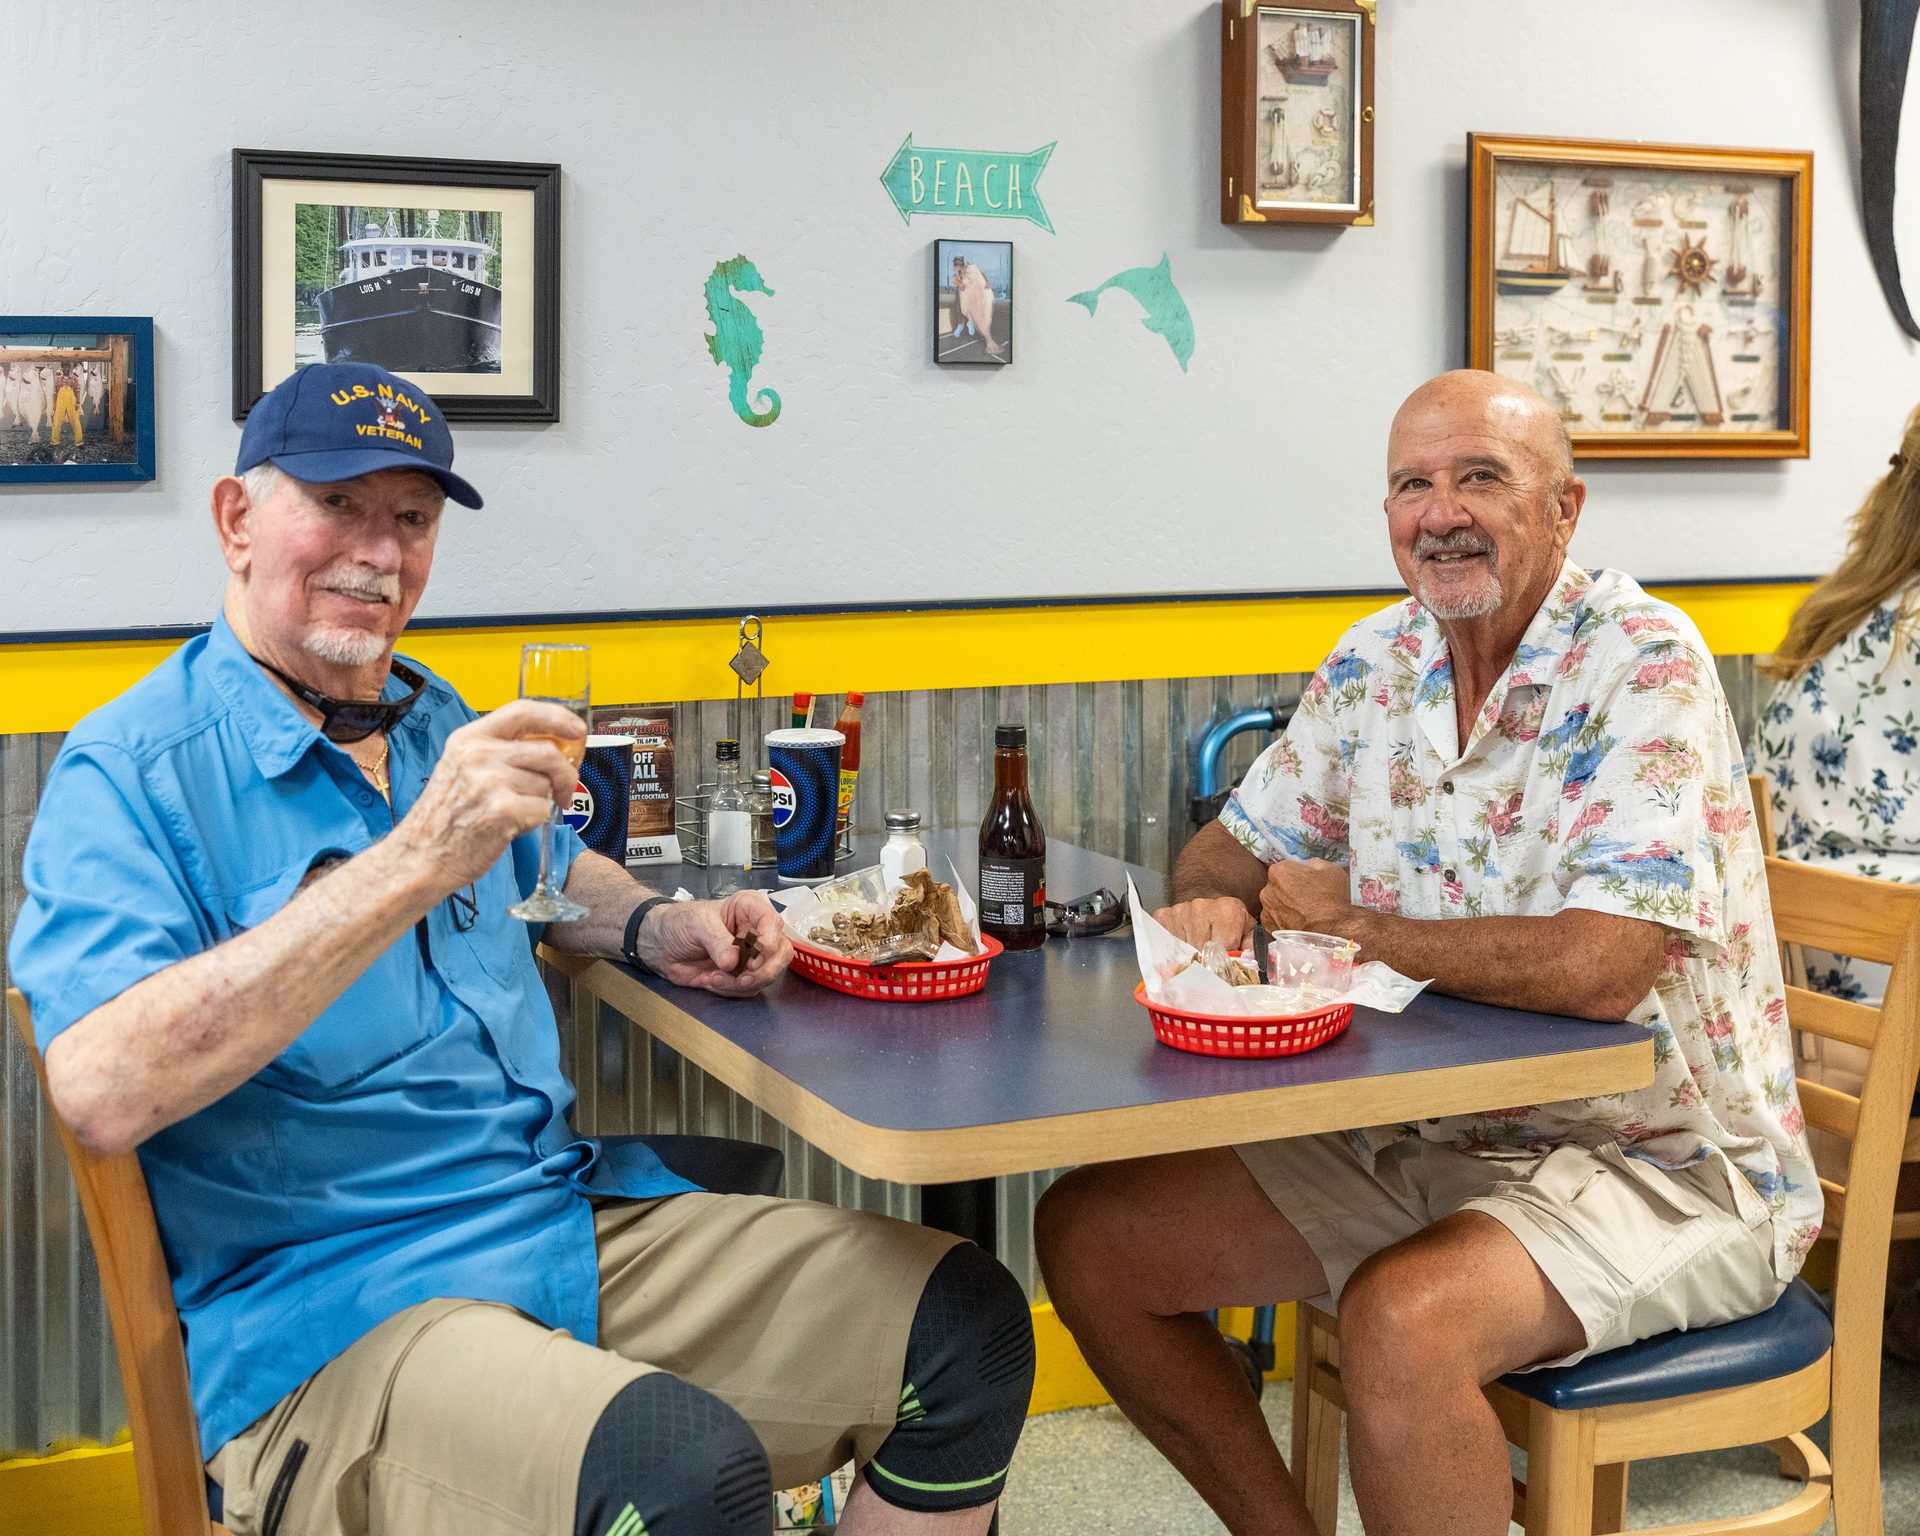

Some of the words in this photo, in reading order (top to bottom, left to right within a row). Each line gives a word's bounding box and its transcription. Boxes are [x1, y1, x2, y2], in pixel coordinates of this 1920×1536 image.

[910, 156, 1023, 210] BEACH
[359, 283, 374, 294] LOIS
[374, 282, 381, 291] M
[460, 283, 473, 295] LOIS
[473, 287, 482, 297] M
[330, 385, 376, 406] U.S.
[377, 383, 432, 424] NAVY
[355, 424, 423, 449] VETERAN
[597, 725, 636, 735] HAPPY
[636, 724, 669, 736] HOUR
[632, 751, 654, 764] OFF
[632, 764, 659, 779] ALL
[636, 782, 662, 793] WINE,
